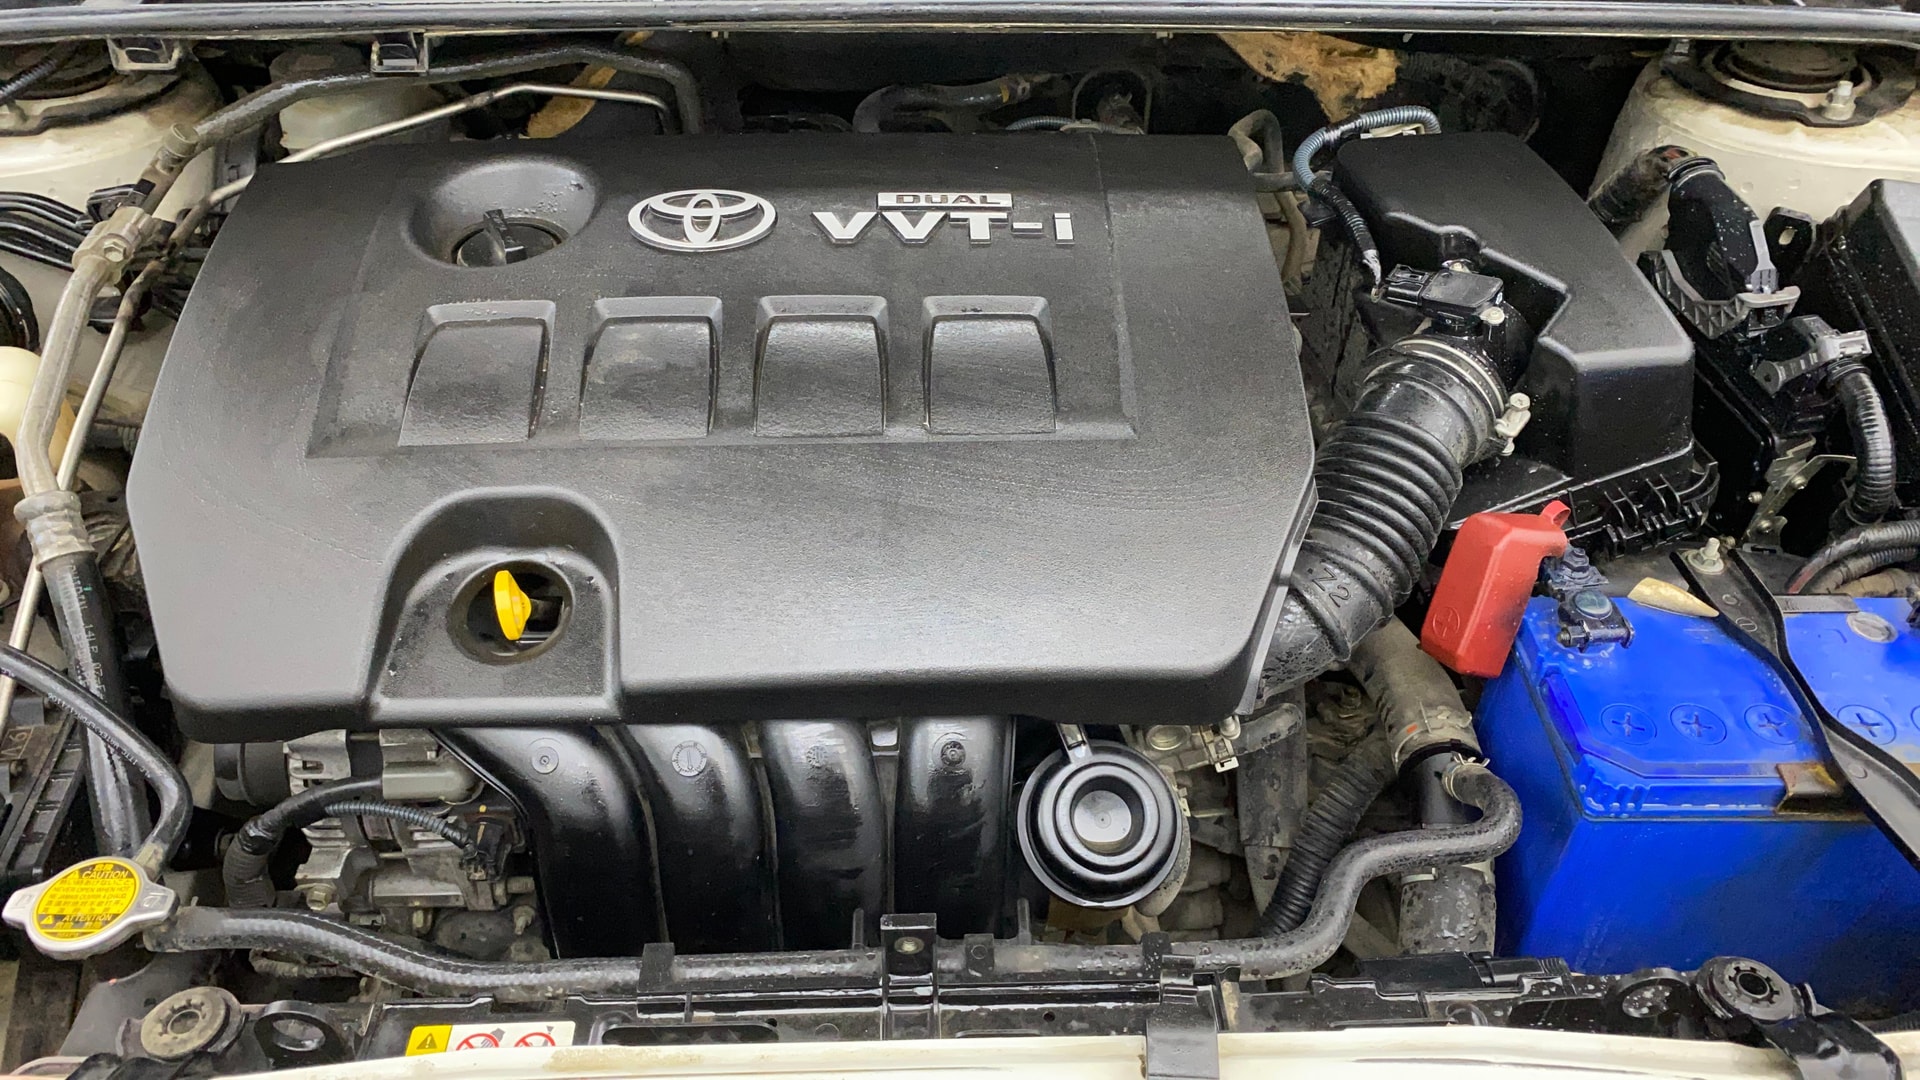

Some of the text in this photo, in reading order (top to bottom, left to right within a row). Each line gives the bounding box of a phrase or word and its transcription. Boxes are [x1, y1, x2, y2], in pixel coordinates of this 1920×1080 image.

[895, 193, 1002, 205] DUAL
[812, 210, 1075, 244] VVT-i
[82, 870, 129, 879] CAUTION
[62, 912, 113, 922] ATTENTION
